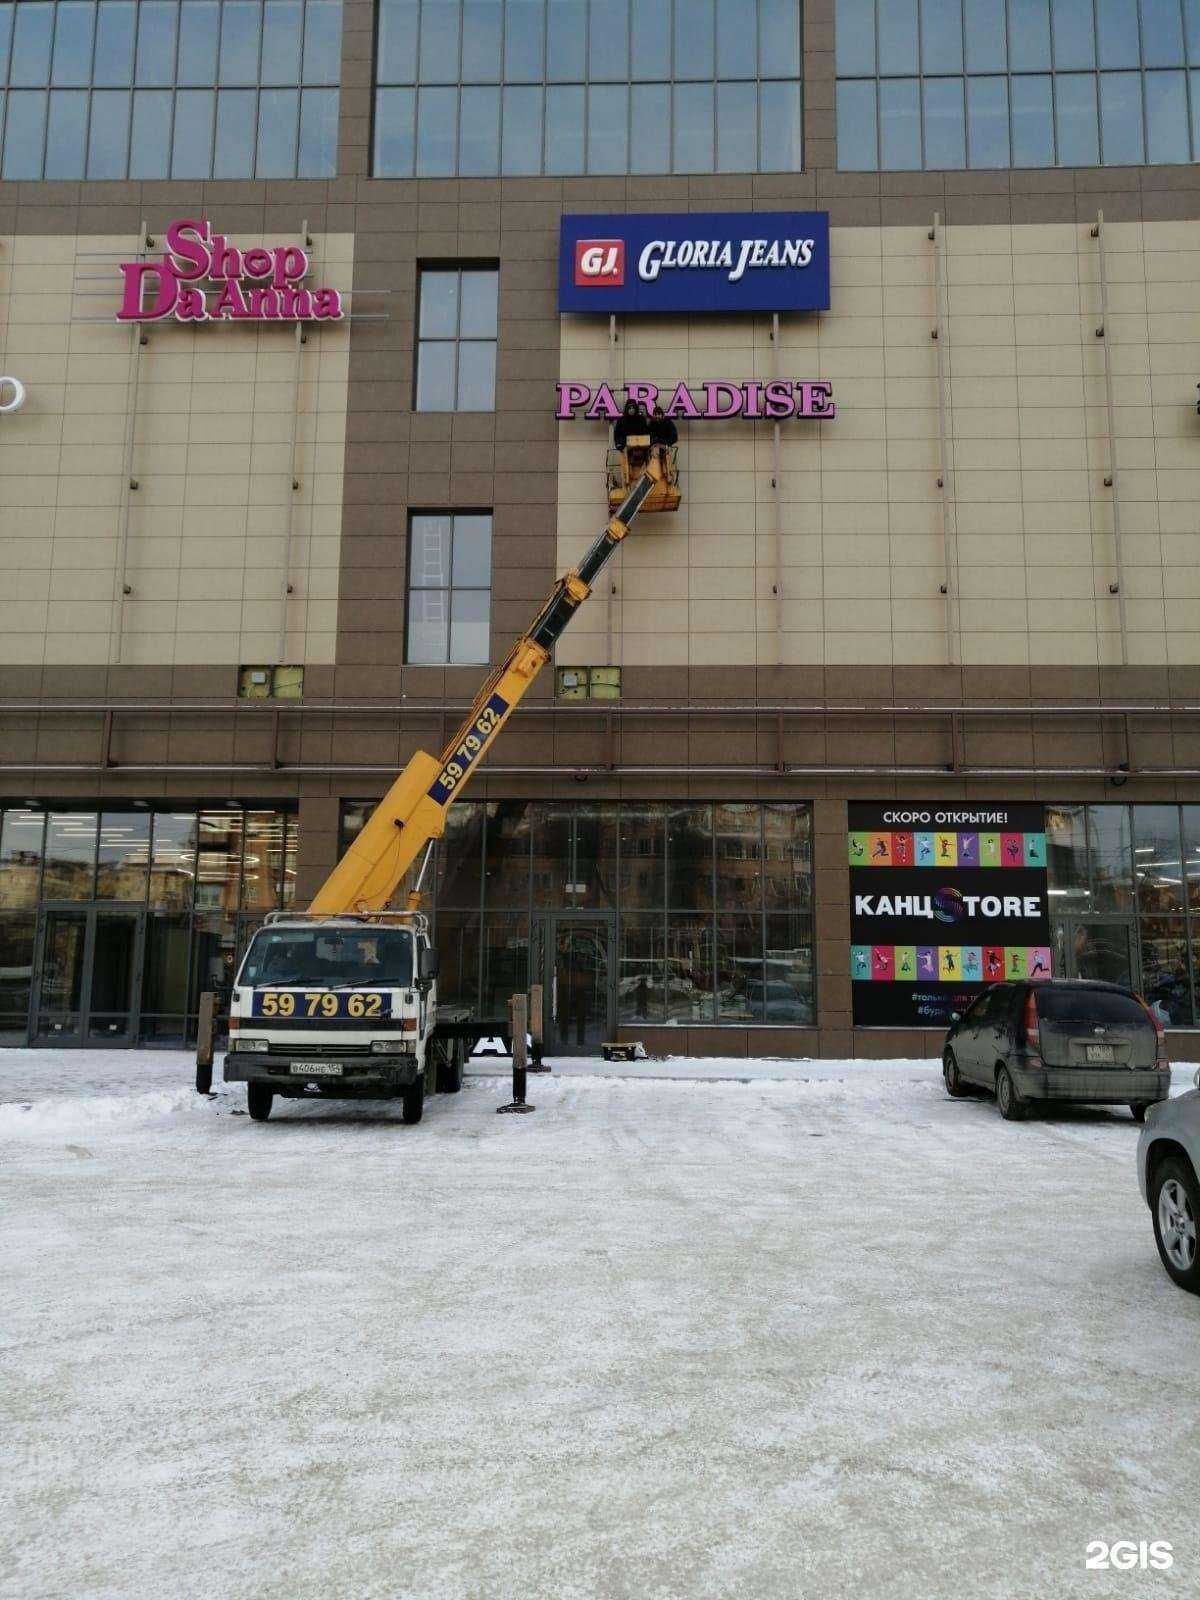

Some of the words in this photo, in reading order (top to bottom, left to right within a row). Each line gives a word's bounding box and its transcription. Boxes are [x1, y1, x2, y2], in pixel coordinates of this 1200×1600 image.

[167, 218, 308, 290] Shop
[638, 240, 732, 280] GLORIA
[728, 239, 814, 281] JEANS
[116, 254, 208, 322] Da
[209, 279, 344, 321] Anna
[555, 381, 836, 420] PARADISE
[439, 762, 463, 790] 59
[457, 734, 481, 762] 79
[476, 707, 501, 735] 62
[883, 811, 931, 824] СКОРО
[934, 811, 1008, 824] ОТКРЫТИЕ!
[262, 993, 295, 1017] 59
[304, 993, 339, 1017] 79
[347, 993, 383, 1017] 62
